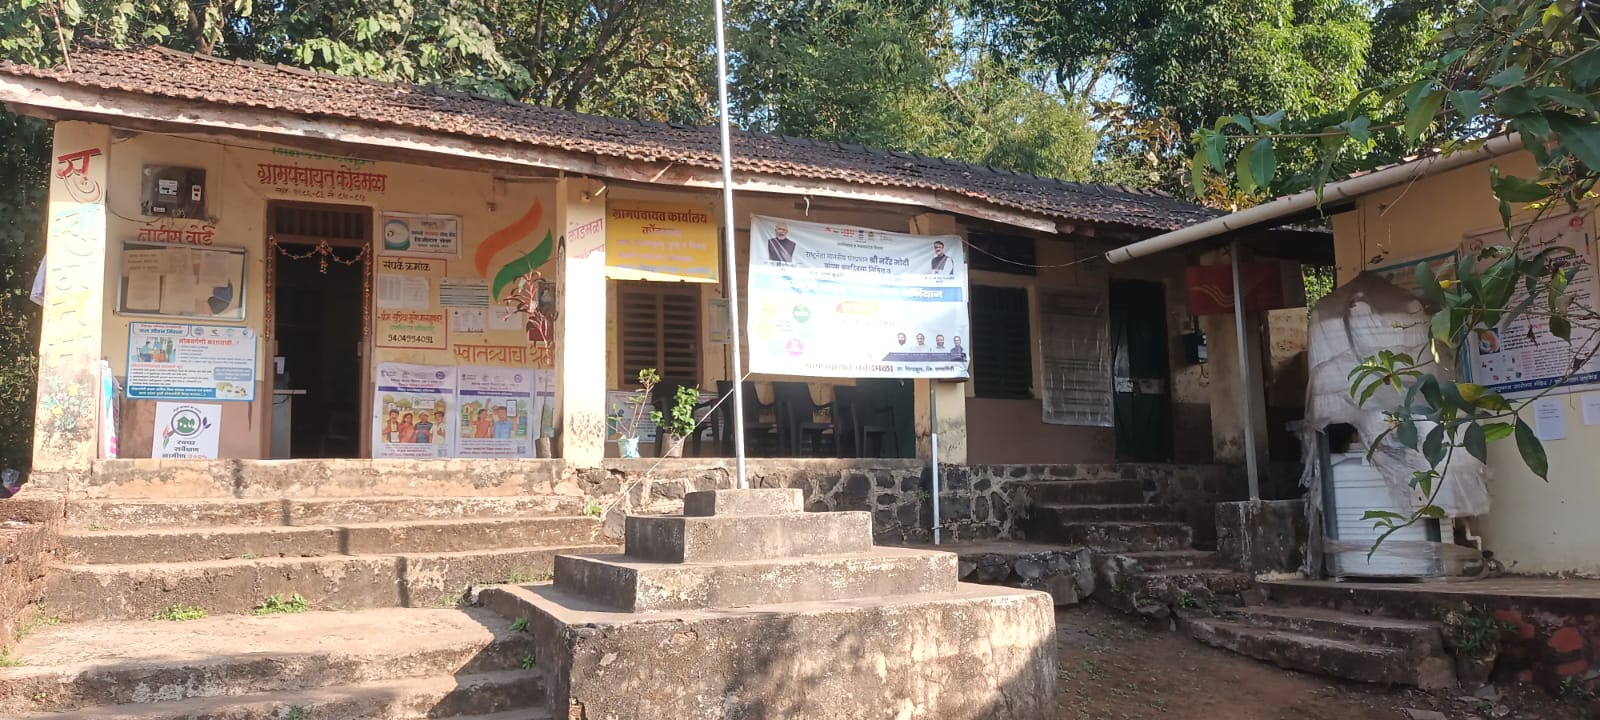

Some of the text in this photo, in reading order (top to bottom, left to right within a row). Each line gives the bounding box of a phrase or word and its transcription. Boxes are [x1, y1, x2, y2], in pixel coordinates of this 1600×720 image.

[257, 162, 388, 194] ग्रामपंचायत कोंडमळा
[612, 207, 708, 224] ग्रामपंचायत कार्यालय
[869, 254, 878, 265] श्री
[894, 257, 910, 267] मोदी
[453, 339, 527, 365] स्वातंत्र्याचा
